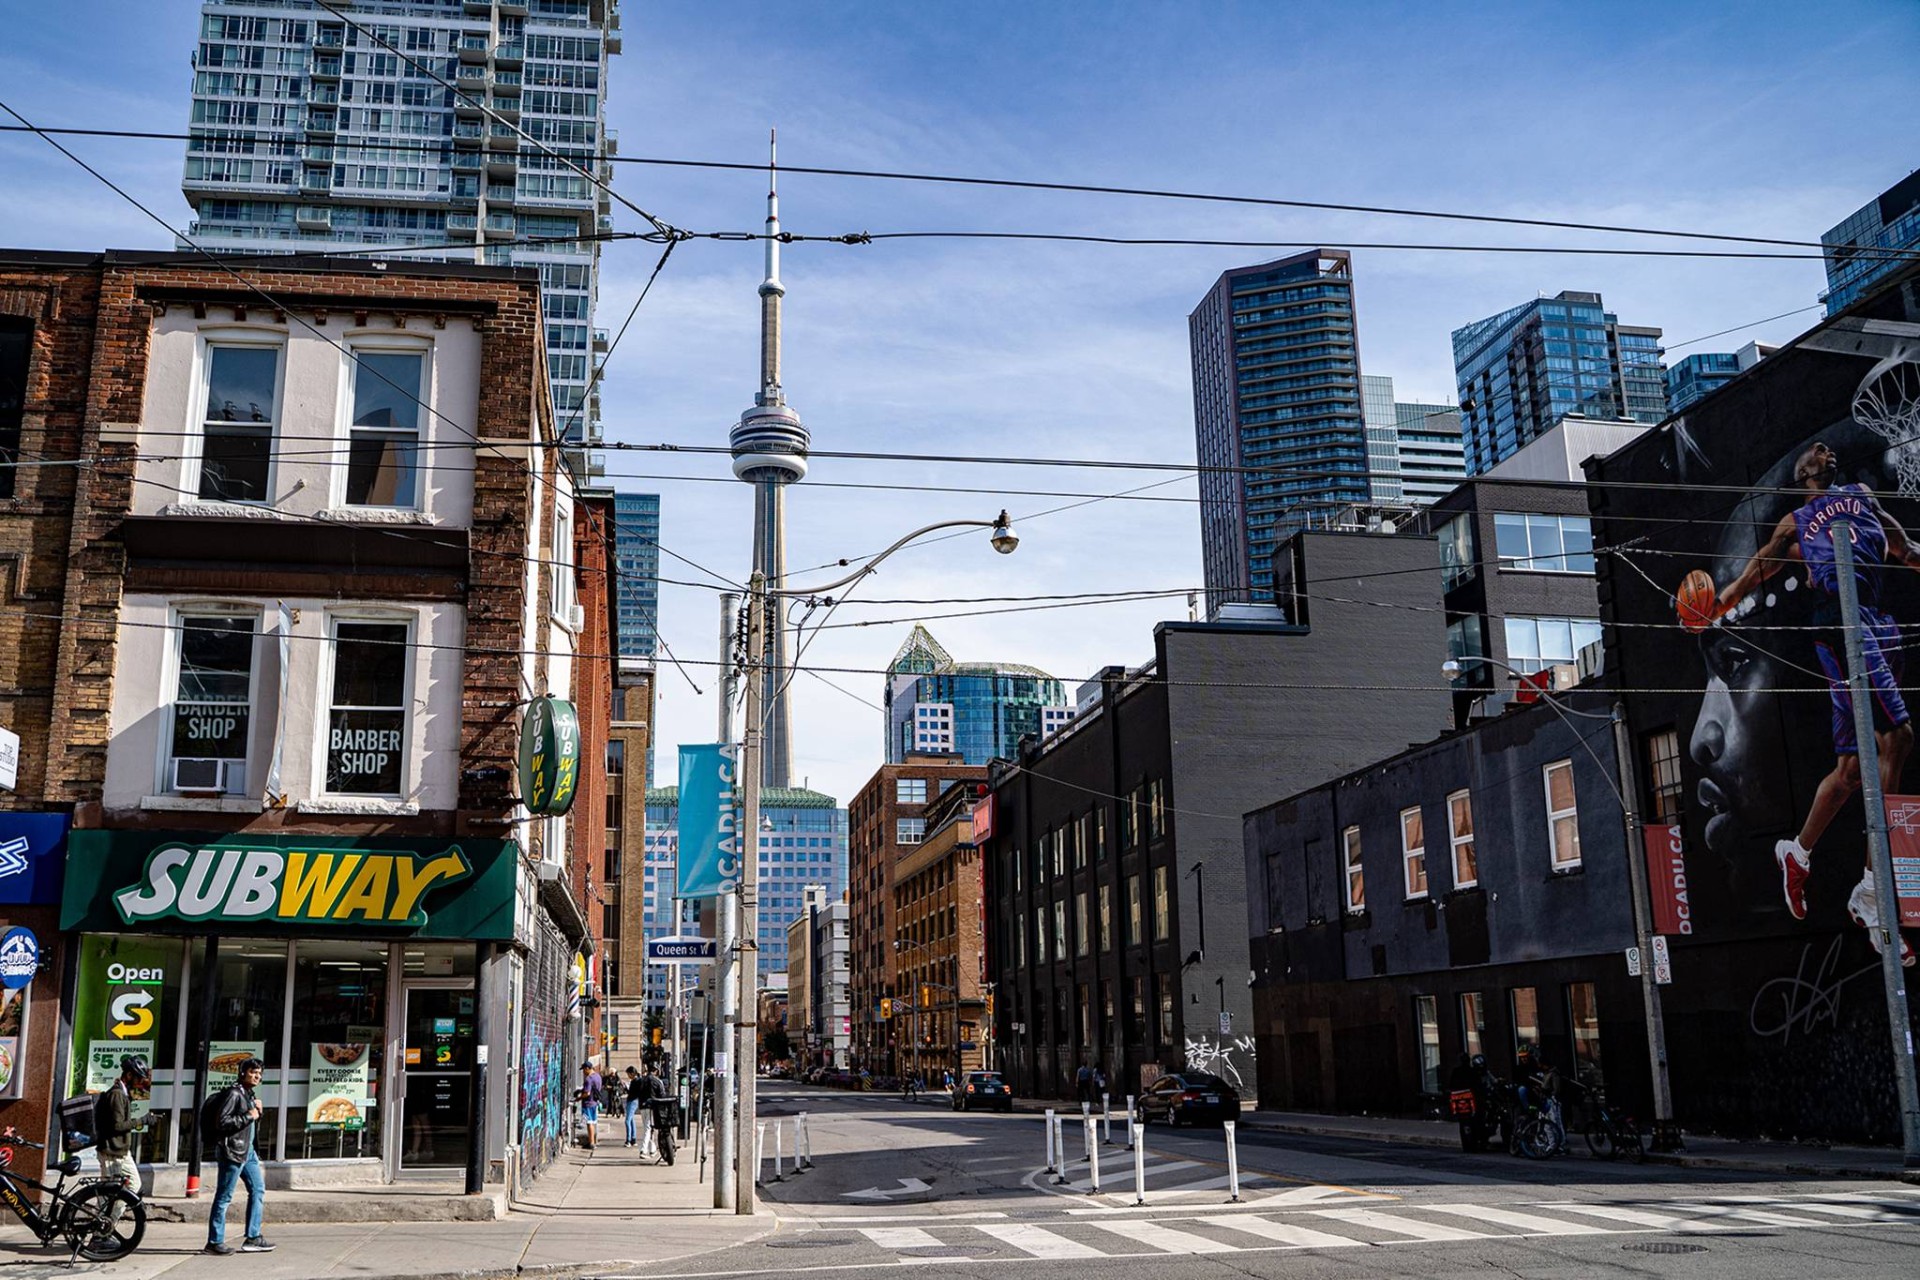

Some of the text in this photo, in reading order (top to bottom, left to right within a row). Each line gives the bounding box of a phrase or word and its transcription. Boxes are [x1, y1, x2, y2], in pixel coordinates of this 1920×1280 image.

[188, 717, 236, 739] SHOP
[331, 729, 401, 751] BARBER
[341, 752, 389, 774] SHOP
[531, 701, 545, 807] SUBWAY
[555, 713, 574, 802] SUBWAY
[717, 743, 738, 896] OCADUCA
[116, 848, 468, 922] SUBWAY
[1668, 824, 1693, 935] OCADU.CA
[107, 963, 163, 984] Open
[656, 944, 709, 956] Queen St W
